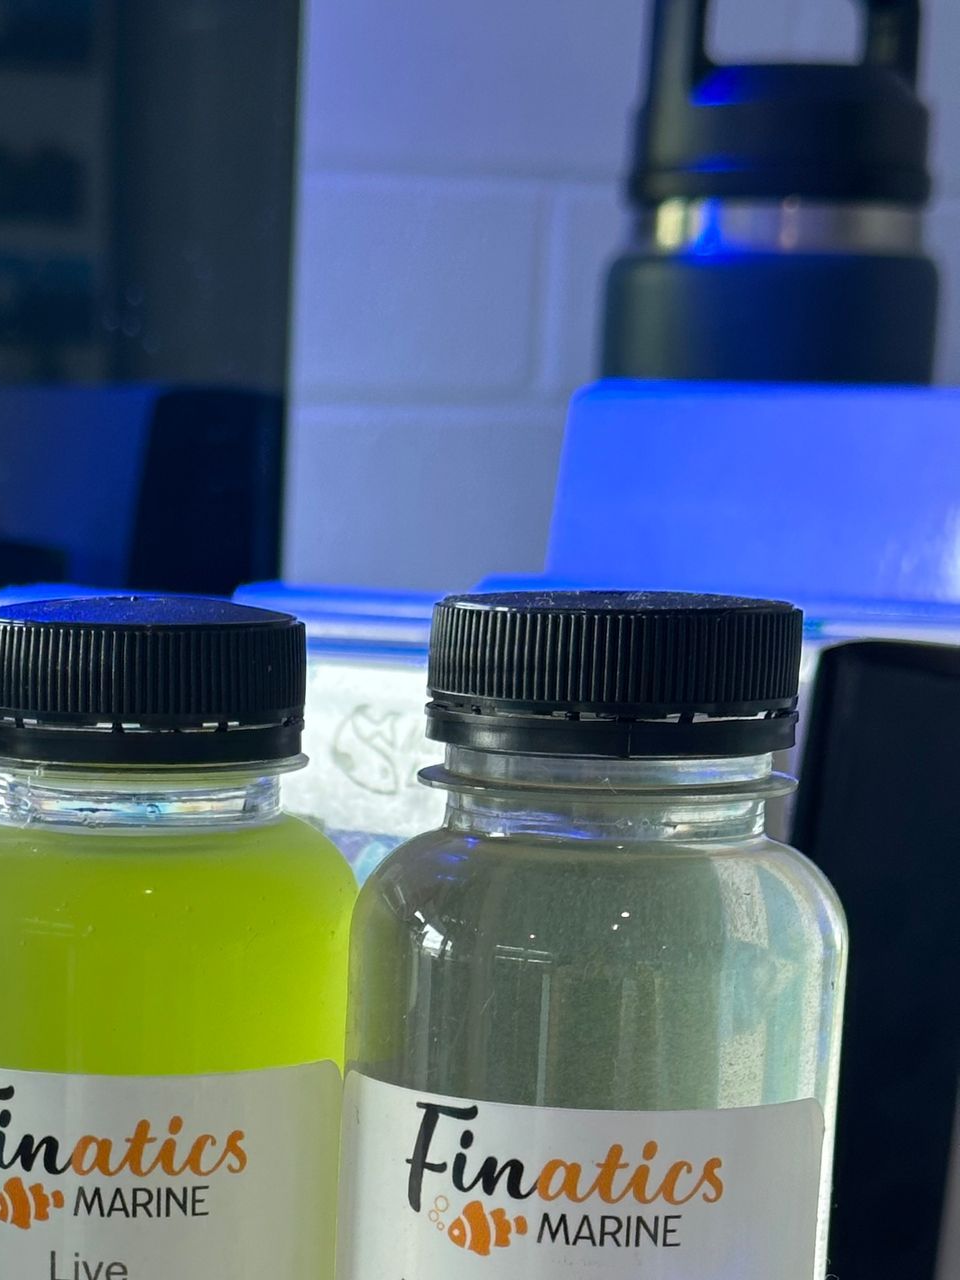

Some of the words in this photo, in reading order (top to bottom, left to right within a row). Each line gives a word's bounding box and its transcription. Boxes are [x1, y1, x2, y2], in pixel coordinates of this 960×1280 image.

[406, 1101, 724, 1213] Finatics
[73, 1185, 209, 1218] MARINE
[537, 1213, 682, 1248] MARINE
